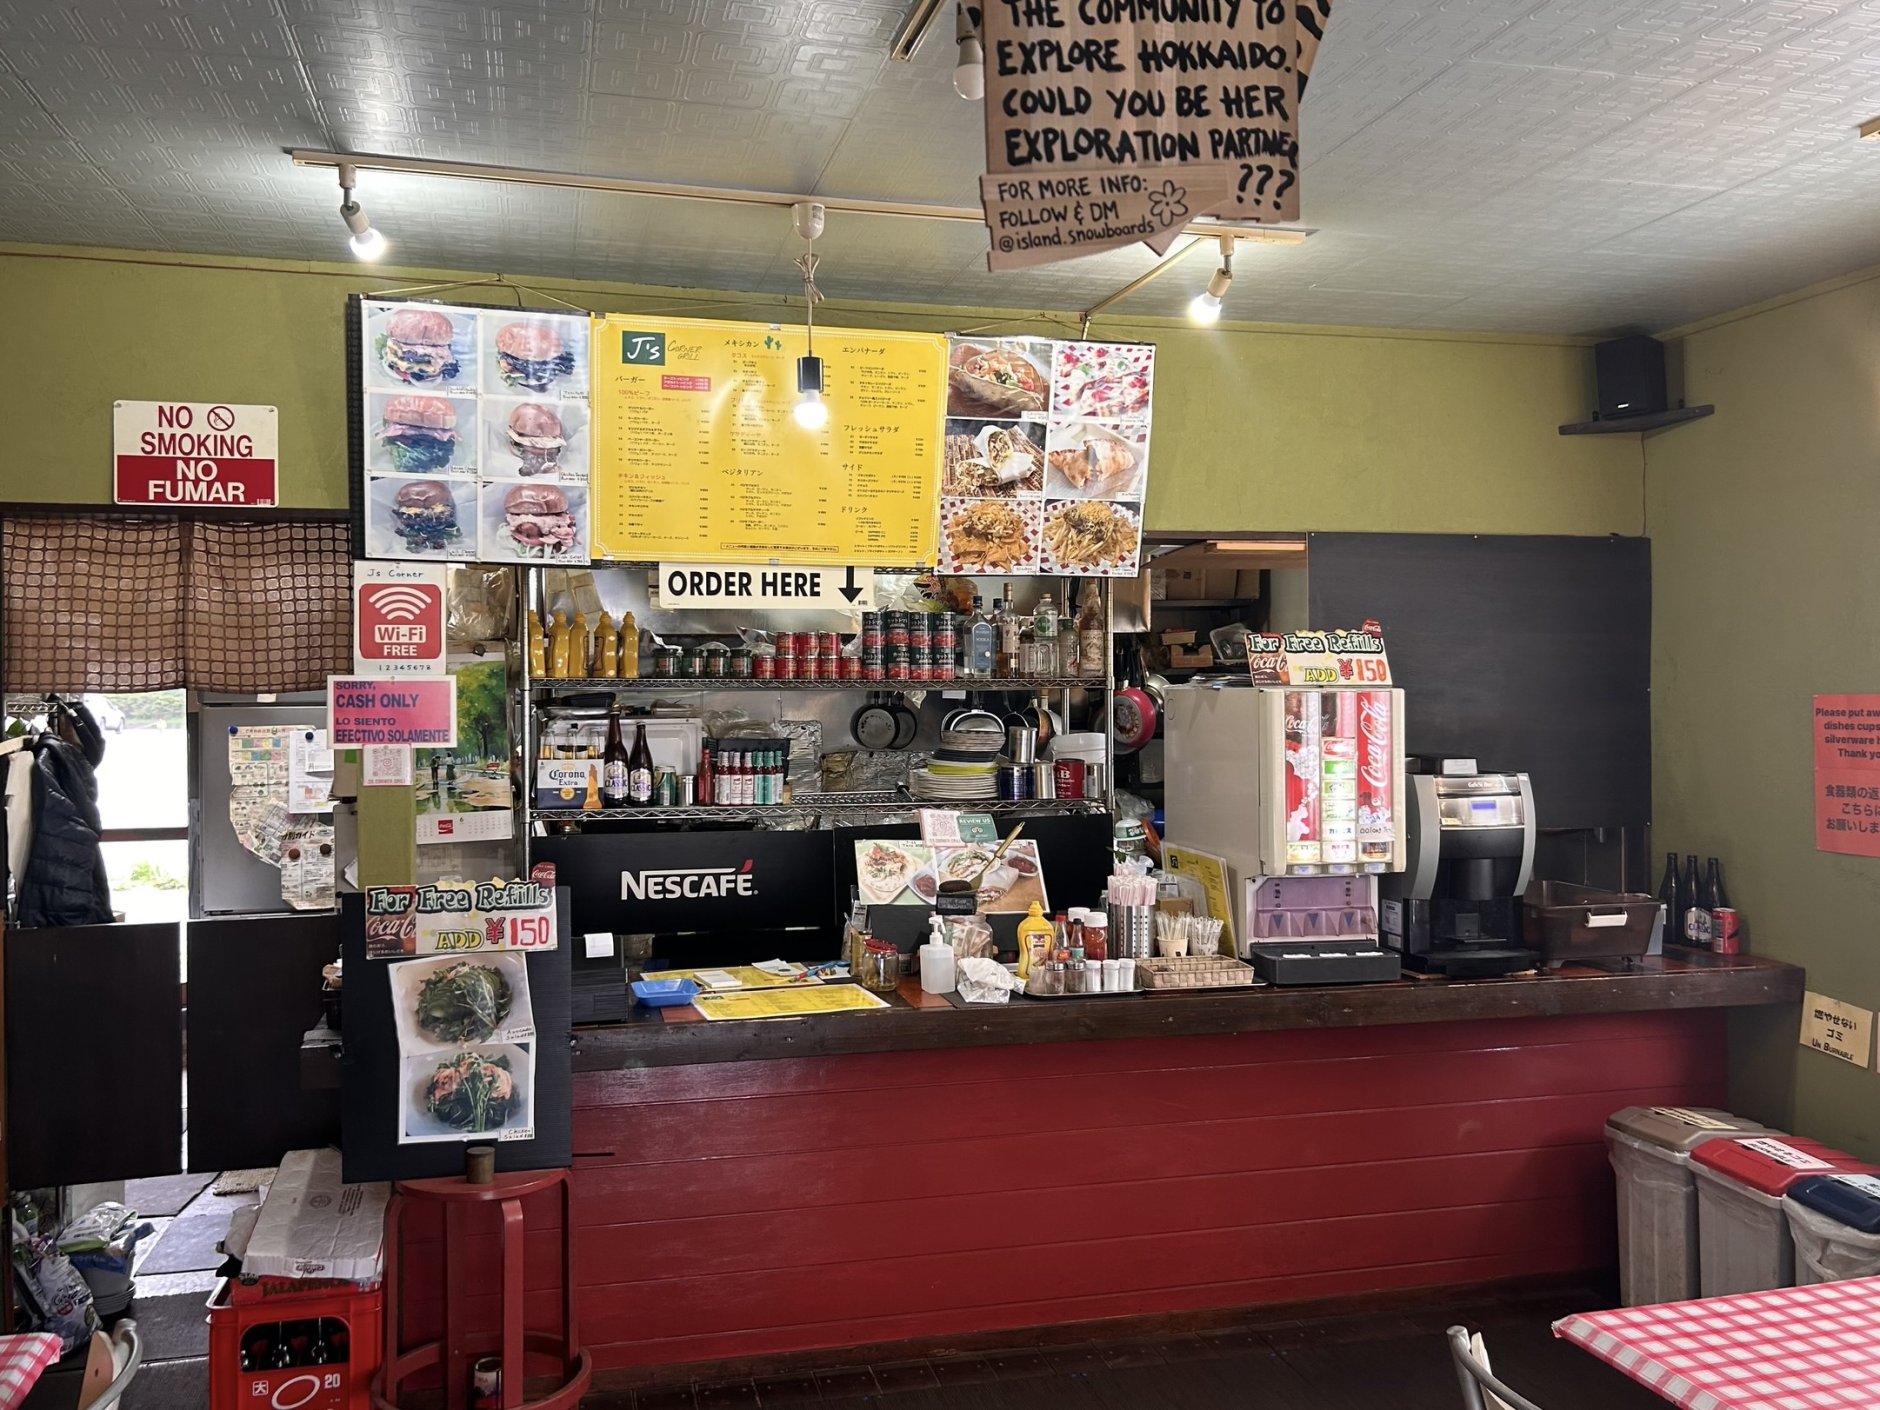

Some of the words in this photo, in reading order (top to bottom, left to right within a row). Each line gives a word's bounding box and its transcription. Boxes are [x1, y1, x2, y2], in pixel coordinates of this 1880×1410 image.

[1008, 0, 1064, 28] THE
[1078, 0, 1241, 27] COMMUNITY
[1254, 0, 1286, 30] TO
[998, 39, 1125, 76] EXPLORE
[1138, 40, 1292, 73] HOKKAIDO.
[1003, 86, 1092, 117] COULD
[1106, 88, 1165, 120] YOU
[1175, 85, 1211, 117] BE
[1220, 85, 1290, 121] HER
[1005, 128, 1200, 166] EXPLORATION
[997, 182, 1034, 202] FOR
[1038, 177, 1089, 201] MORE
[1099, 176, 1149, 194] INFO:
[1236, 163, 1295, 211] ???
[999, 208, 1068, 229] FOLLOW
[1072, 204, 1085, 226] &
[1090, 200, 1120, 221] DM
[998, 217, 1156, 253] @island.snowboards
[627, 336, 661, 360] J's
[724, 339, 760, 348] メキシカン
[158, 405, 193, 429] NO
[843, 424, 900, 433] フレッシュサラダ
[140, 431, 253, 457] SMOKING
[176, 460, 218, 481] NO
[842, 463, 863, 471] サイド
[148, 480, 245, 502] FUMAR
[841, 505, 868, 514] ドリンク
[388, 568, 424, 578] Corner
[668, 571, 752, 596] ORDER
[761, 572, 821, 597] HERE
[377, 626, 424, 642] Wi-Fi
[1249, 634, 1279, 652] For
[1284, 634, 1325, 652] Free
[1326, 633, 1382, 652] Refills
[383, 644, 418, 656] FREE
[1304, 667, 1338, 683] ADD
[335, 694, 375, 708] CASH
[380, 694, 419, 708] ONLY
[336, 718, 350, 726] LO
[354, 717, 396, 726] SIENTO
[1815, 708, 1847, 718] Please
[1848, 709, 1864, 718] put
[1824, 722, 1855, 730] dishes
[335, 730, 384, 743] EFECTIVO
[387, 729, 449, 742] SOLAMENTE
[1360, 695, 1389, 788] Coca-Cola
[1824, 735, 1875, 744] silverware
[1838, 747, 1867, 758] Thank
[549, 769, 586, 780] Corona
[369, 888, 411, 914] For
[416, 885, 470, 912] Free
[475, 881, 553, 911] Refills
[435, 928, 485, 951] ADD
[1814, 1009, 1857, 1030] 燃やせない
[1826, 1028, 1843, 1042] ゴミ
[324, 1373, 341, 1389] 20
